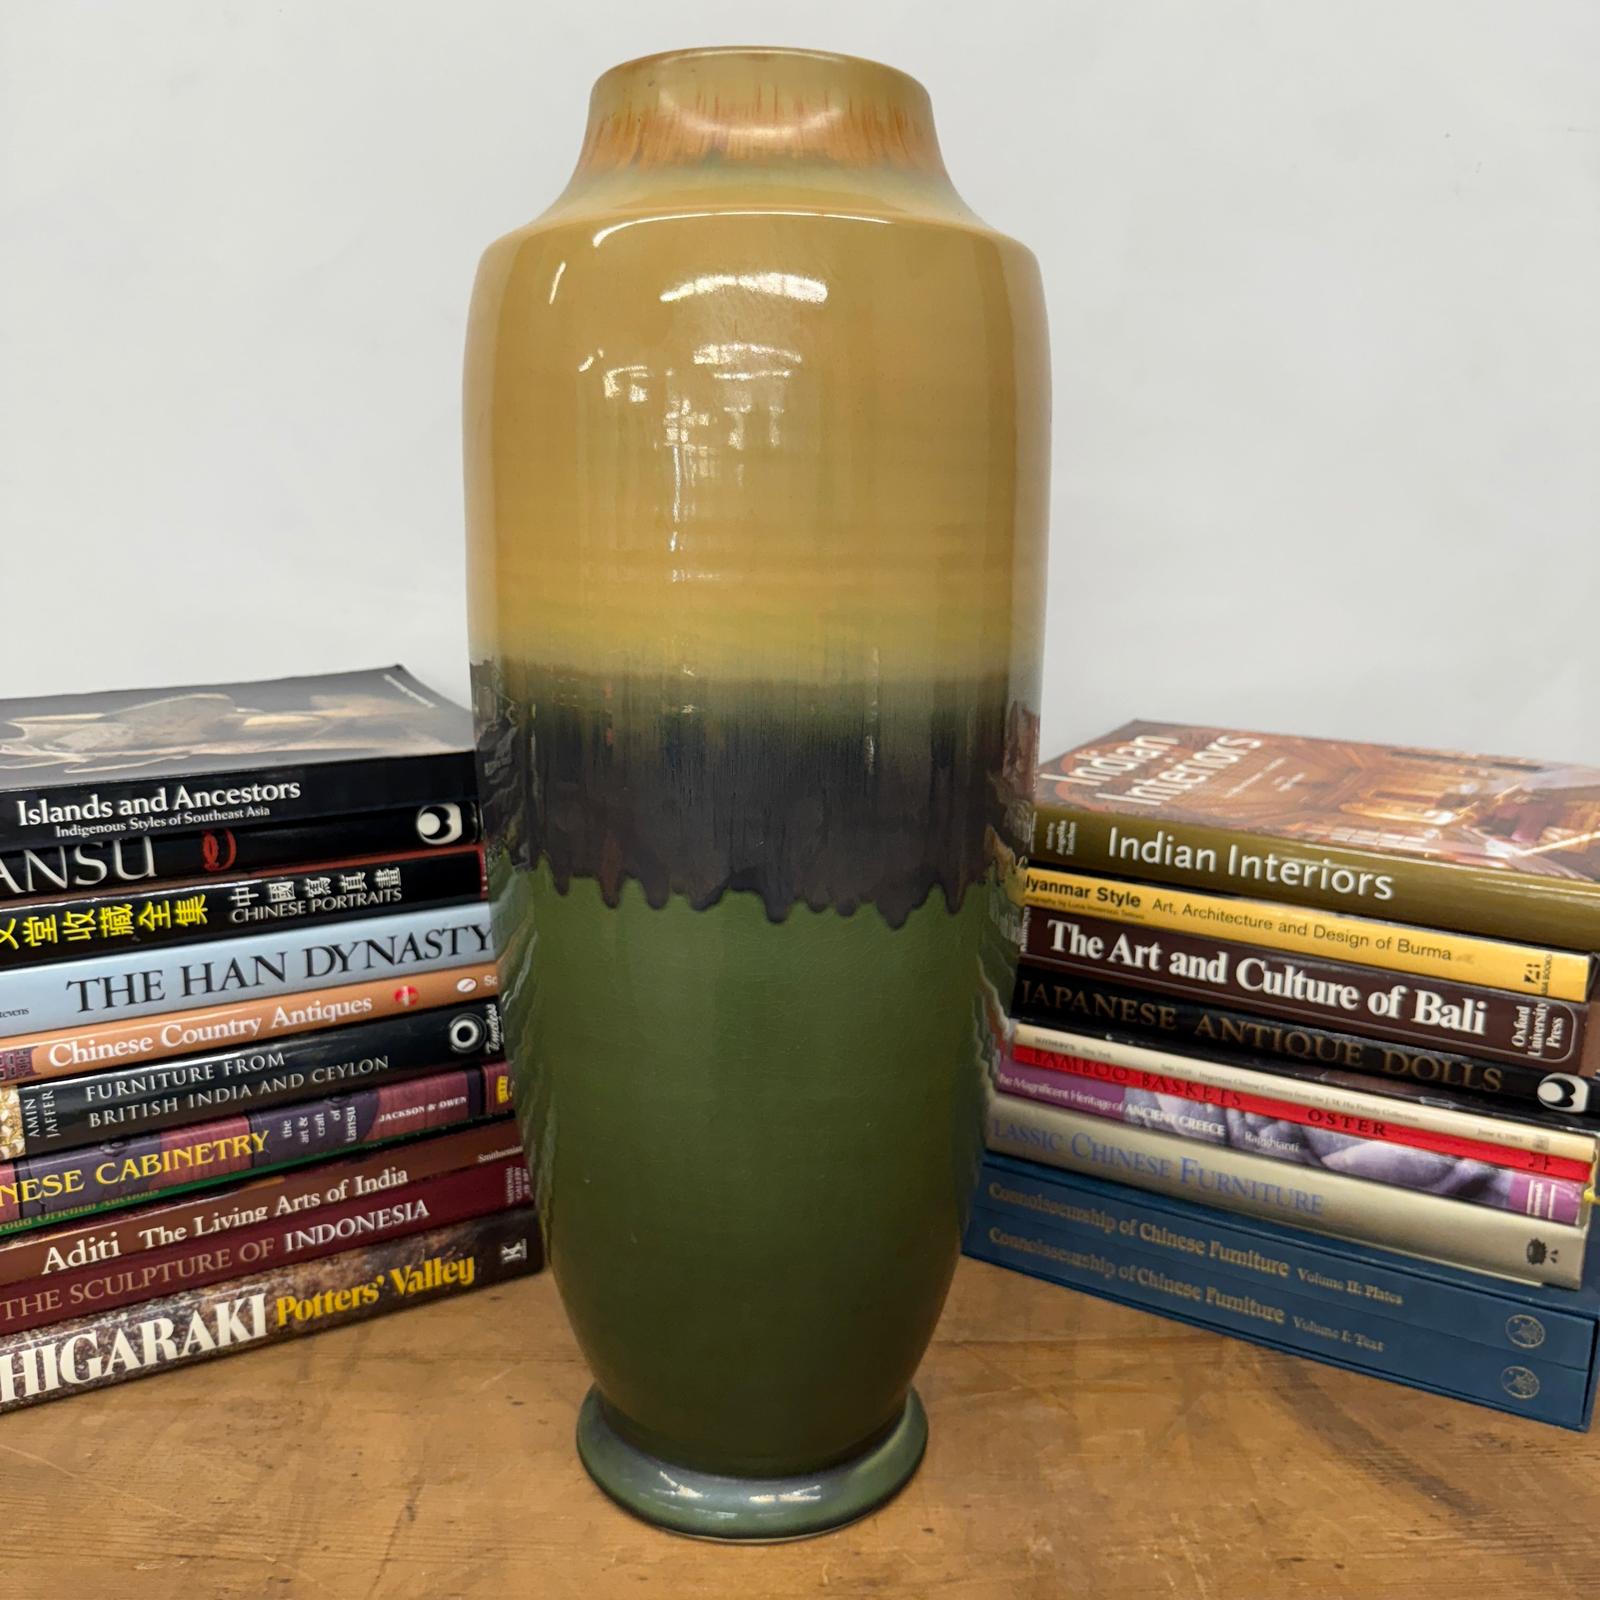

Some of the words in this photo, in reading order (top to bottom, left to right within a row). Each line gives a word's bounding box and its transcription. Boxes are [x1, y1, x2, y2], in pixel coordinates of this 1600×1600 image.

[1040, 734, 1180, 787] Indian
[1096, 735, 1262, 806] Interiors
[17, 794, 113, 826] Islands
[119, 787, 170, 816] and
[173, 782, 301, 810] Ancestors
[56, 822, 127, 838] Indigenous
[129, 817, 167, 831] Styles
[169, 812, 182, 826] of
[184, 809, 245, 825] Southeast
[246, 806, 270, 818] Asia
[1108, 826, 1217, 873] Indian
[1228, 844, 1394, 900] Interiors
[232, 901, 306, 924] CHINESE
[311, 888, 402, 914] PORTRAITS
[1096, 887, 1142, 909] Style
[1152, 898, 1177, 917] Art,
[1182, 904, 1273, 931] Architecture
[1278, 921, 1308, 937] and
[1313, 924, 1370, 949] Design
[1375, 936, 1393, 950] of
[1397, 938, 1452, 961] Burma
[66, 969, 166, 1013] THE
[180, 951, 288, 997] HAN
[302, 925, 491, 979] DYNASTY
[1047, 920, 1105, 960] The
[1107, 933, 1163, 972] Art
[1169, 951, 1229, 984] and
[1236, 957, 1360, 1011] Culture
[1367, 985, 1408, 1020] of
[1412, 989, 1488, 1036] Bali
[48, 1038, 153, 1067] Chinese
[160, 1017, 262, 1055] Country
[270, 997, 373, 1030] Antiques
[1021, 979, 1177, 1031] JAPANESE
[1194, 1012, 1364, 1065] ANTIQUE
[1380, 1050, 1504, 1093] DOLLS
[1511, 1005, 1531, 1047] Oxford
[1527, 1002, 1550, 1056] University
[1545, 1017, 1564, 1048] Press
[86, 1064, 215, 1102] FURNITURE
[224, 1053, 285, 1080] FROM
[89, 1097, 178, 1129] BRITISH
[188, 1083, 251, 1109] INDIA
[260, 1073, 304, 1095] AND
[312, 1055, 389, 1084] CEYLON
[1033, 1049, 1129, 1083] BAMBOO
[1141, 1066, 1243, 1106] BASKETS
[24, 1098, 40, 1138] AMIN
[41, 1090, 61, 1139] JAFFER
[281, 1120, 292, 1139] the
[378, 1105, 425, 1123] JACKSON
[439, 1096, 467, 1110] OWEN
[1125, 1103, 1175, 1126] ANCIENT
[1178, 1115, 1226, 1136] GREECE
[1307, 1109, 1387, 1136] OSTER
[95, 1130, 269, 1185] CABINETRY
[1071, 1132, 1171, 1178] CHINESE
[1180, 1156, 1323, 1216] FURNITURE
[41, 1231, 122, 1276] Aditi
[138, 1225, 187, 1249] The
[193, 1206, 268, 1237] Living
[274, 1193, 321, 1219] Arts
[327, 1178, 349, 1201] of
[355, 1166, 409, 1196] India
[0, 1289, 63, 1320] THE
[69, 1248, 233, 1303] SCULPTURE
[239, 1238, 276, 1263] OF
[283, 1199, 430, 1251] INDONESIA
[1119, 1219, 1137, 1235] of
[1140, 1222, 1205, 1255] Chinese
[1209, 1241, 1290, 1278] Furniture
[1296, 1267, 1343, 1291] Volume
[1365, 1284, 1403, 1305] Plates
[0, 1293, 268, 1401] HIGARAKI
[390, 1256, 475, 1295] Valley
[1119, 1265, 1136, 1281] of
[1137, 1268, 1200, 1300] Chinese
[1205, 1287, 1285, 1324] Furniture
[1293, 1316, 1340, 1341] Volume
